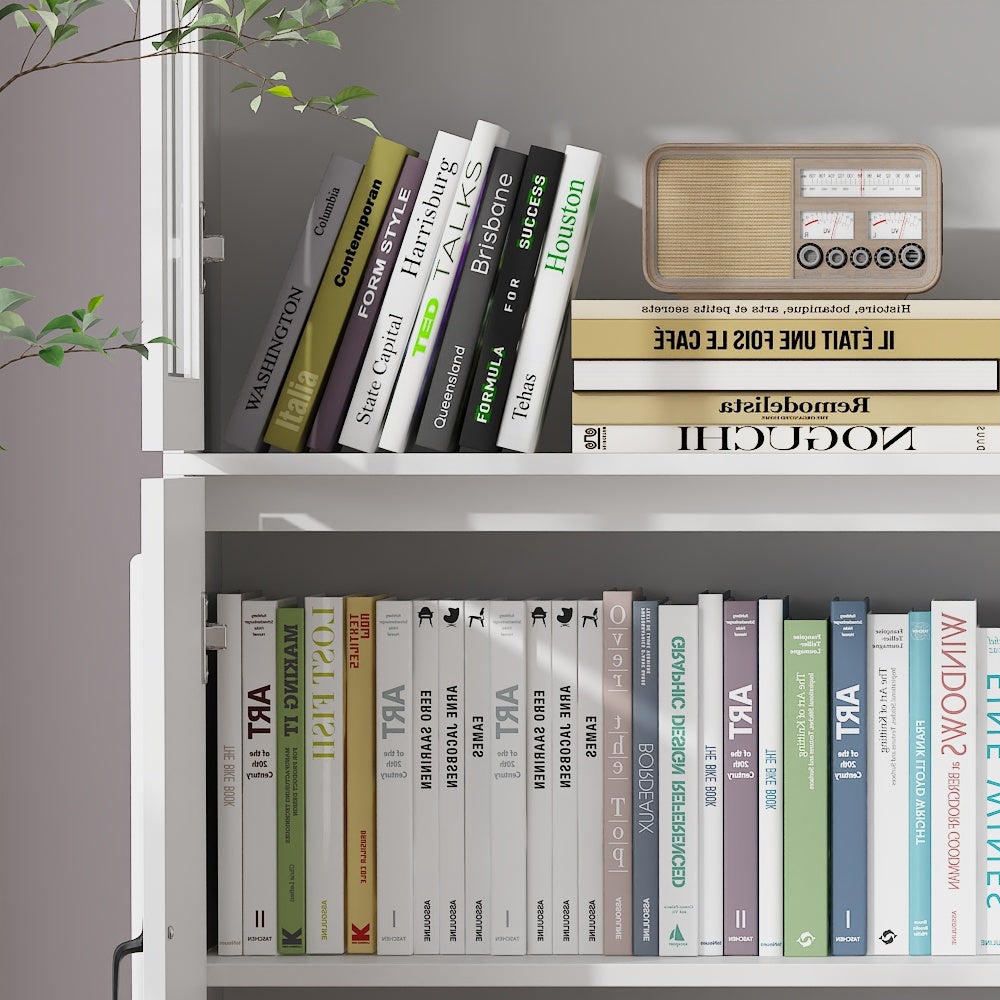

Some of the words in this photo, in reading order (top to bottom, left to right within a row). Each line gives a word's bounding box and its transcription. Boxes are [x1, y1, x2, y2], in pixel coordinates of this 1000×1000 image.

[314, 186, 340, 237] Columbia
[334, 179, 382, 288] Contemporan
[358, 258, 386, 319] FORM
[381, 188, 412, 254] STYLE
[401, 157, 459, 278] Harrisburg
[412, 298, 440, 358] TED
[433, 160, 483, 280] TALKS
[472, 173, 513, 275] Brisbane
[544, 179, 585, 274] Houston
[245, 286, 304, 411] WASHINGTON
[476, 347, 506, 423] FORMULA
[504, 278, 520, 313] FOR
[518, 174, 547, 250] SUCCESS
[275, 369, 320, 432] Italia
[355, 379, 382, 425] State
[372, 314, 404, 376] Capital
[434, 345, 465, 429] Queensland
[512, 373, 537, 421] Tehas
